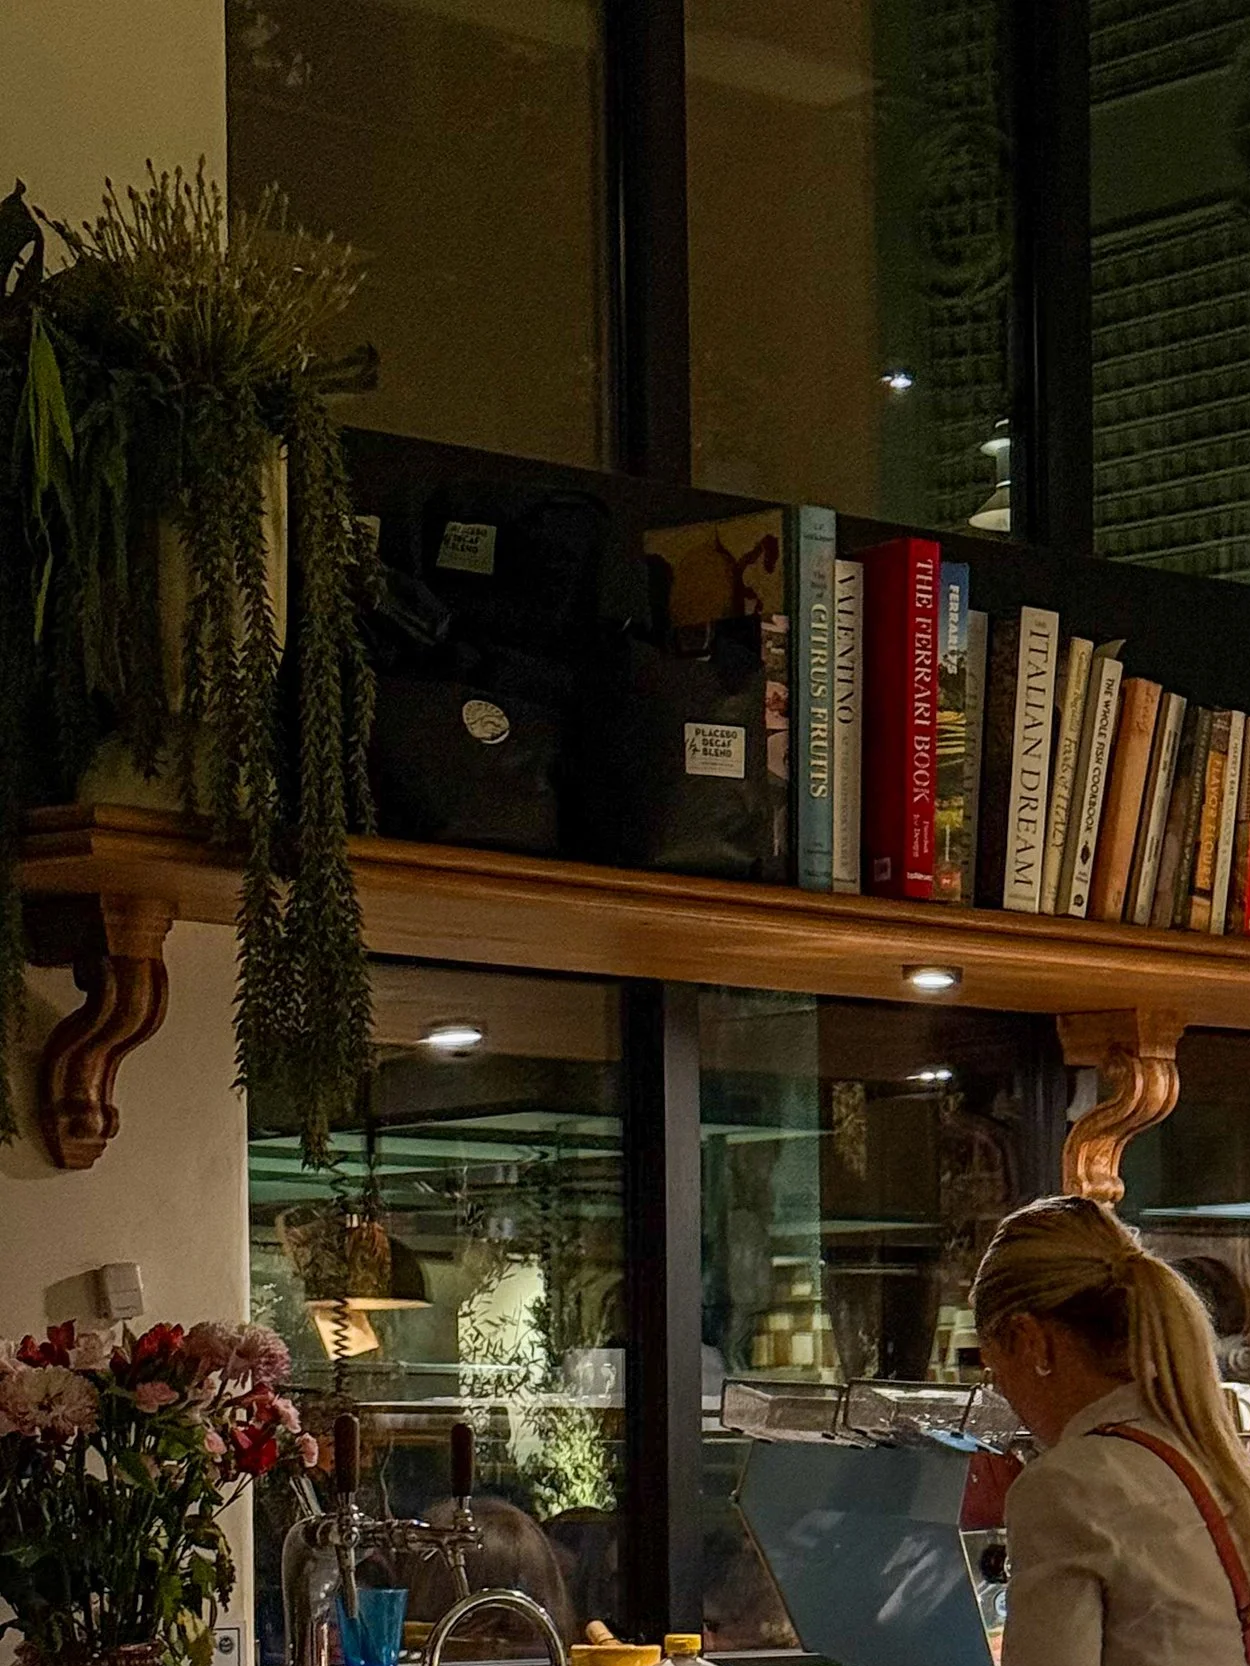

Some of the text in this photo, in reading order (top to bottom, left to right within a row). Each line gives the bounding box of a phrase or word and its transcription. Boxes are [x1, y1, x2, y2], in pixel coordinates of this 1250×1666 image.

[915, 558, 933, 609] THE
[947, 583, 960, 651] FERRARI
[809, 603, 830, 698] CITRUS
[836, 572, 856, 725] VALENTINO
[914, 615, 933, 726] FERRARI
[694, 727, 738, 739] PLACEBO
[701, 738, 732, 748] DECAF
[701, 747, 733, 758] BLEND
[808, 706, 830, 799] FRUITS
[912, 734, 932, 804] BOOK
[1013, 629, 1051, 887] ITALIAN DREAM
[1084, 677, 1115, 835] THE WHOLE FISH COOKBOOK
[1200, 759, 1222, 886] FLAVOR FLOURS
